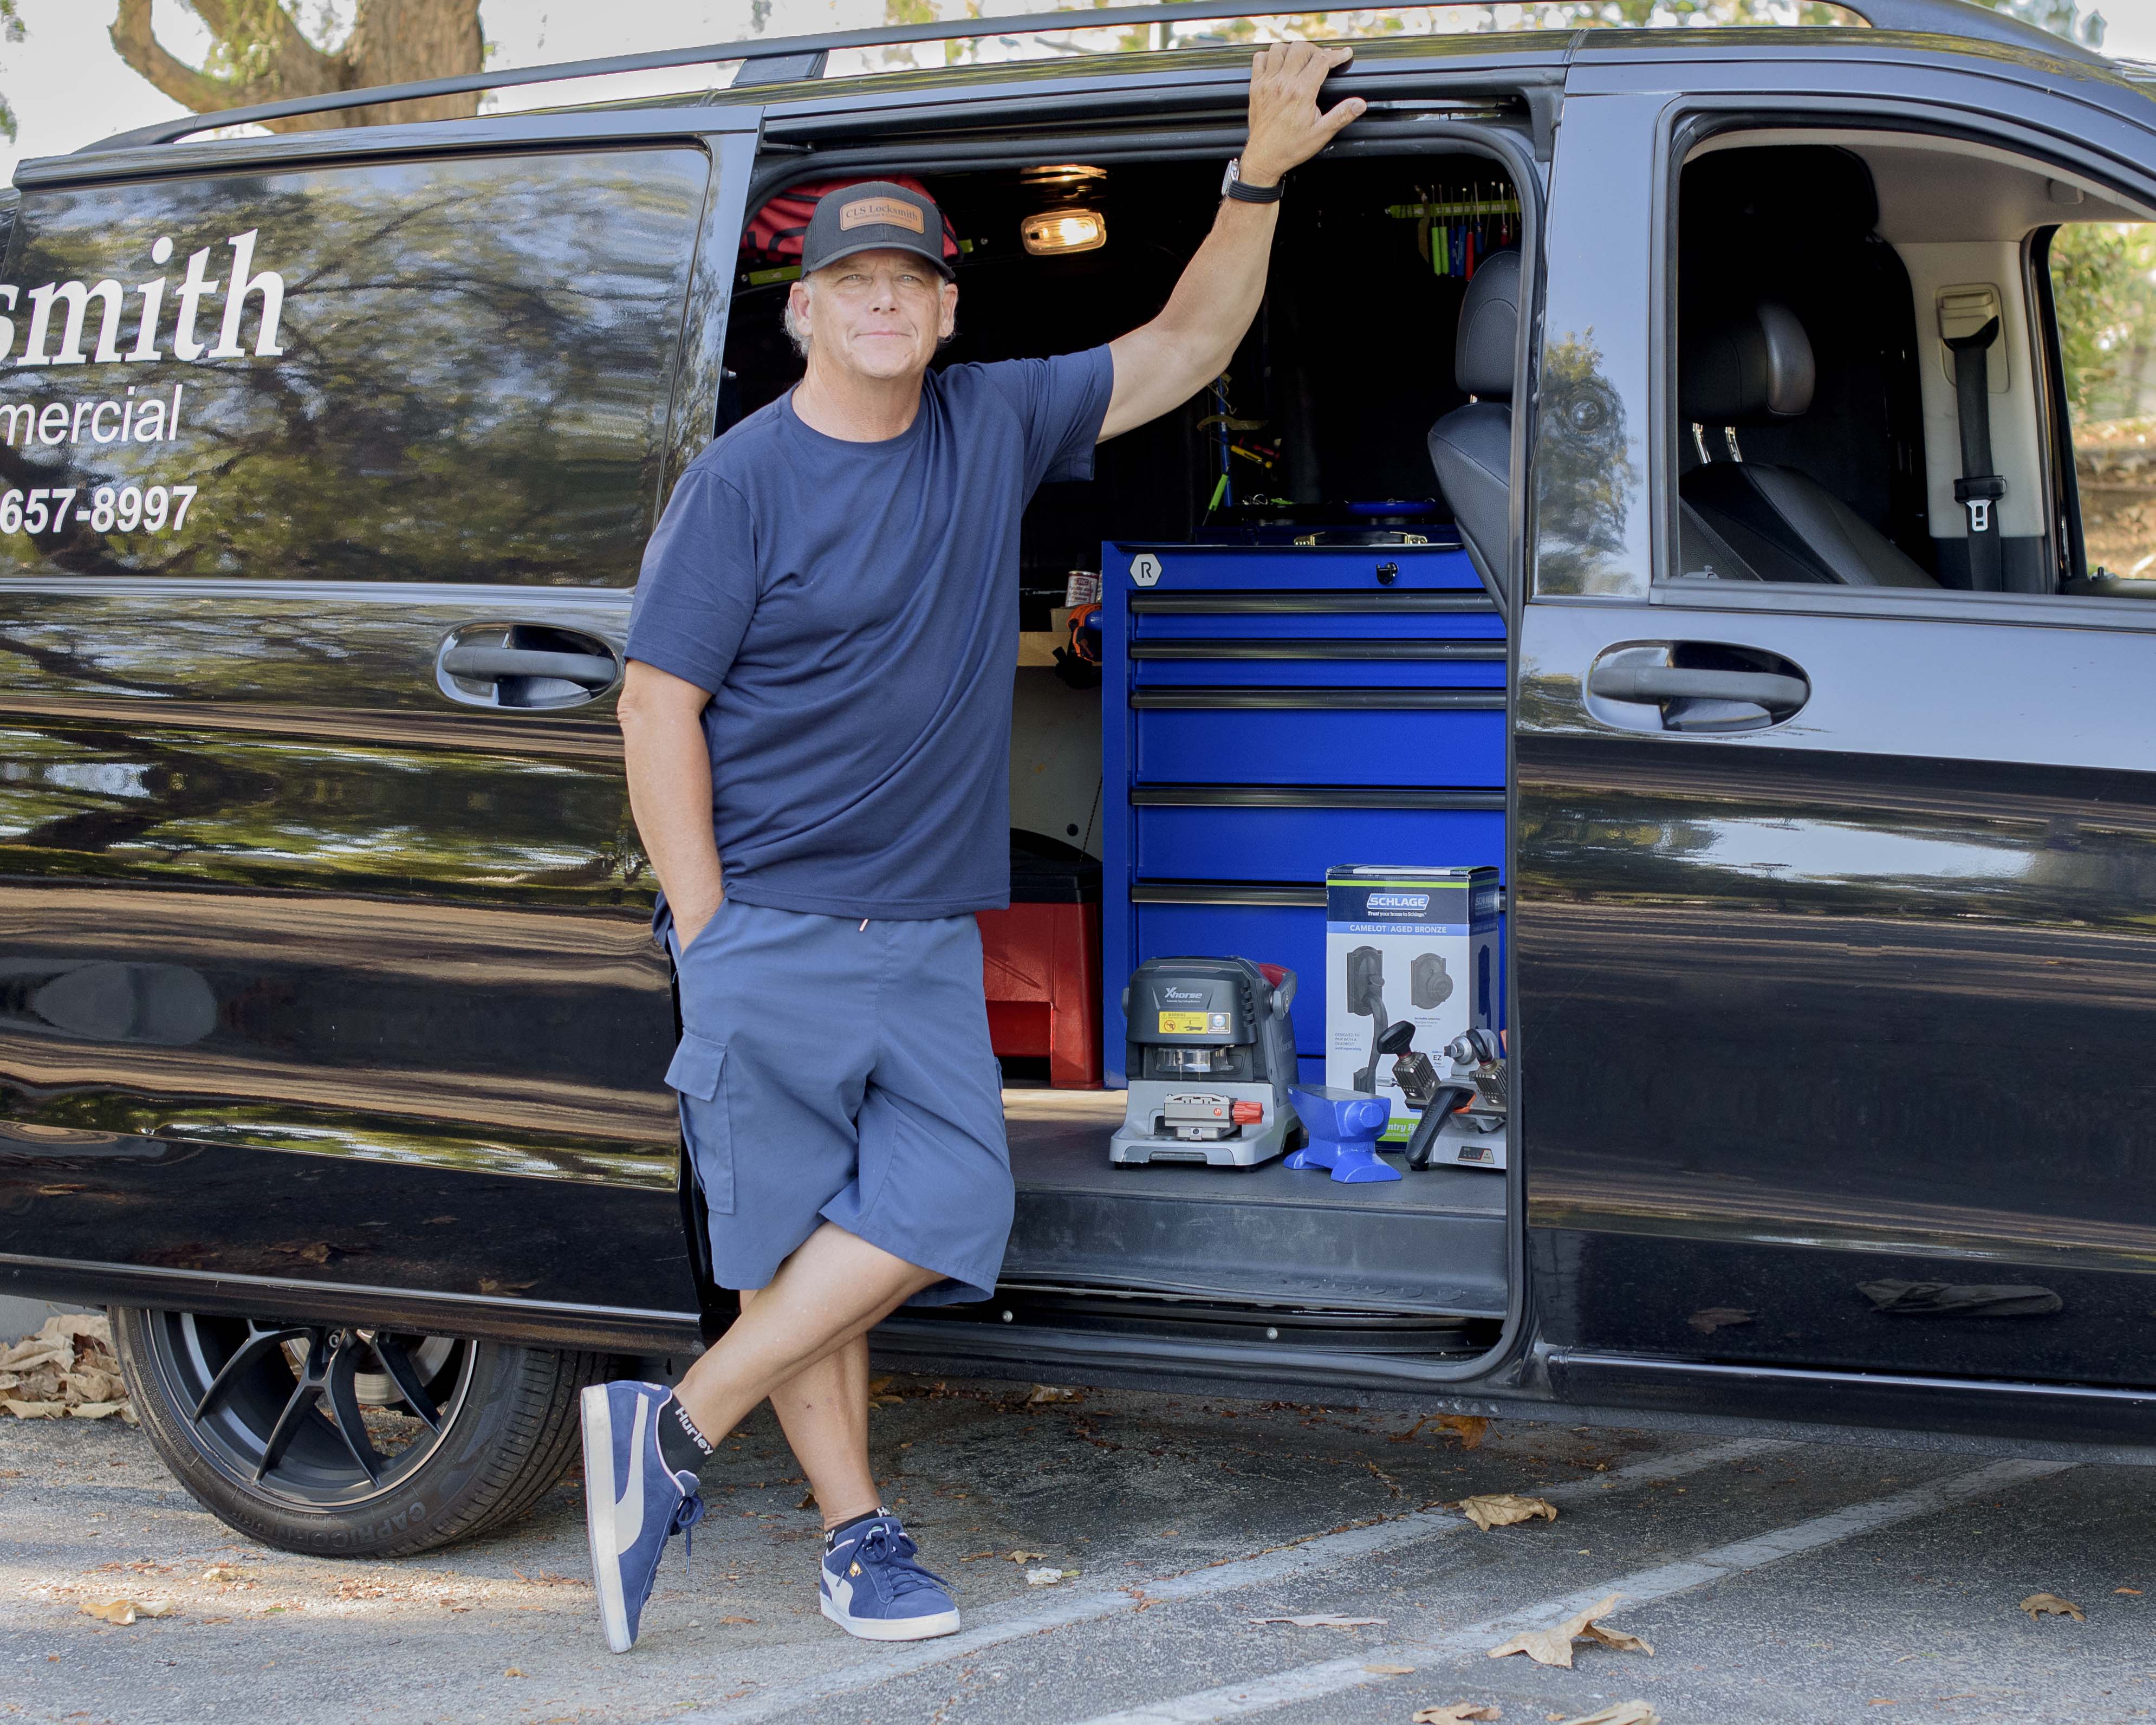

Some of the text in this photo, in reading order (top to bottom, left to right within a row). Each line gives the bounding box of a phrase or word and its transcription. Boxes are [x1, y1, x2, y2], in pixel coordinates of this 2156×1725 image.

[846, 204, 918, 221] CLS Locksmith
[1, 484, 198, 534] 657-8997
[1141, 562, 1152, 578] R
[1368, 897, 1426, 906] SCHLAGE
[1349, 924, 1447, 933] CAMELOT AGED BRONZE
[1164, 987, 1203, 998] Xhorse
[674, 1406, 713, 1456] Hurley
